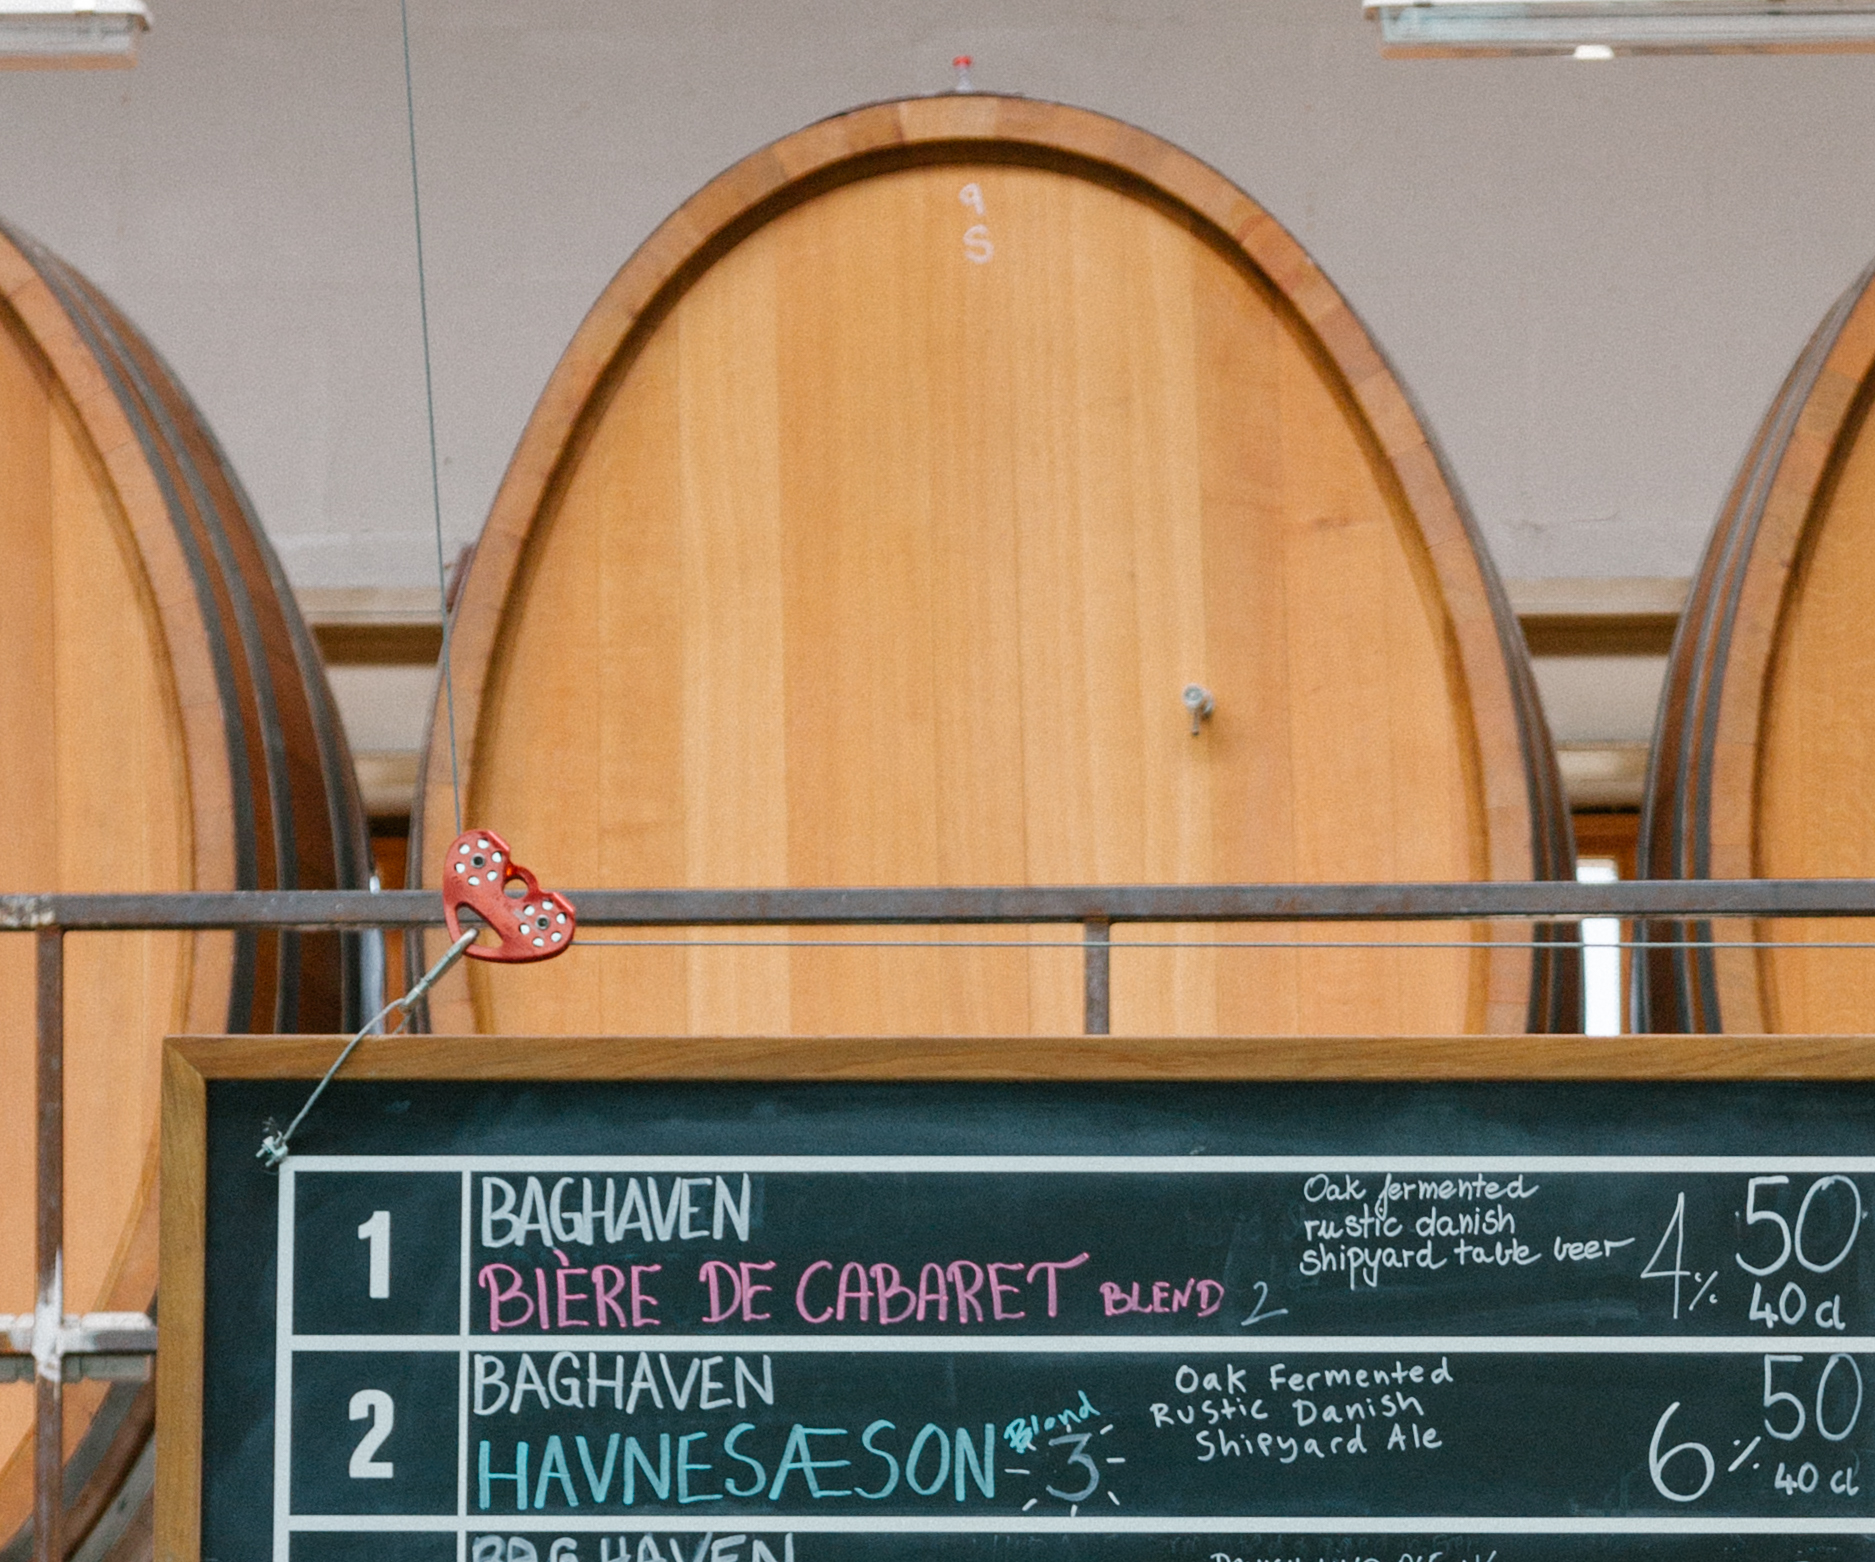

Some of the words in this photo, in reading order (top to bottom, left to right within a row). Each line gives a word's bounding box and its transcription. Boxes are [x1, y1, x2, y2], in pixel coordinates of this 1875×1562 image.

[959, 183, 985, 216] 9
[481, 1174, 751, 1247] BAGHAVEN
[1303, 1175, 1367, 1202] Oak
[1375, 1174, 1538, 1220] fermented
[1304, 1210, 1401, 1239] rustic
[1417, 1206, 1515, 1237] danish
[1736, 1175, 1864, 1279] 50
[357, 1210, 390, 1299] 1
[1300, 1239, 1447, 1289] shipyard
[478, 1250, 661, 1333] BIÈRE
[699, 1259, 777, 1323] DE
[797, 1252, 1090, 1325] CABARET
[1100, 1279, 1231, 1318] BLEND
[474, 1352, 775, 1415] BAGHAVEN
[1175, 1364, 1248, 1392] Oak
[1270, 1358, 1454, 1389] Fermented
[1762, 1352, 1862, 1441] 50
[348, 1389, 395, 1479] 2
[479, 1420, 995, 1510] HAVNESÆSON
[1196, 1429, 1364, 1462] Shipyard
